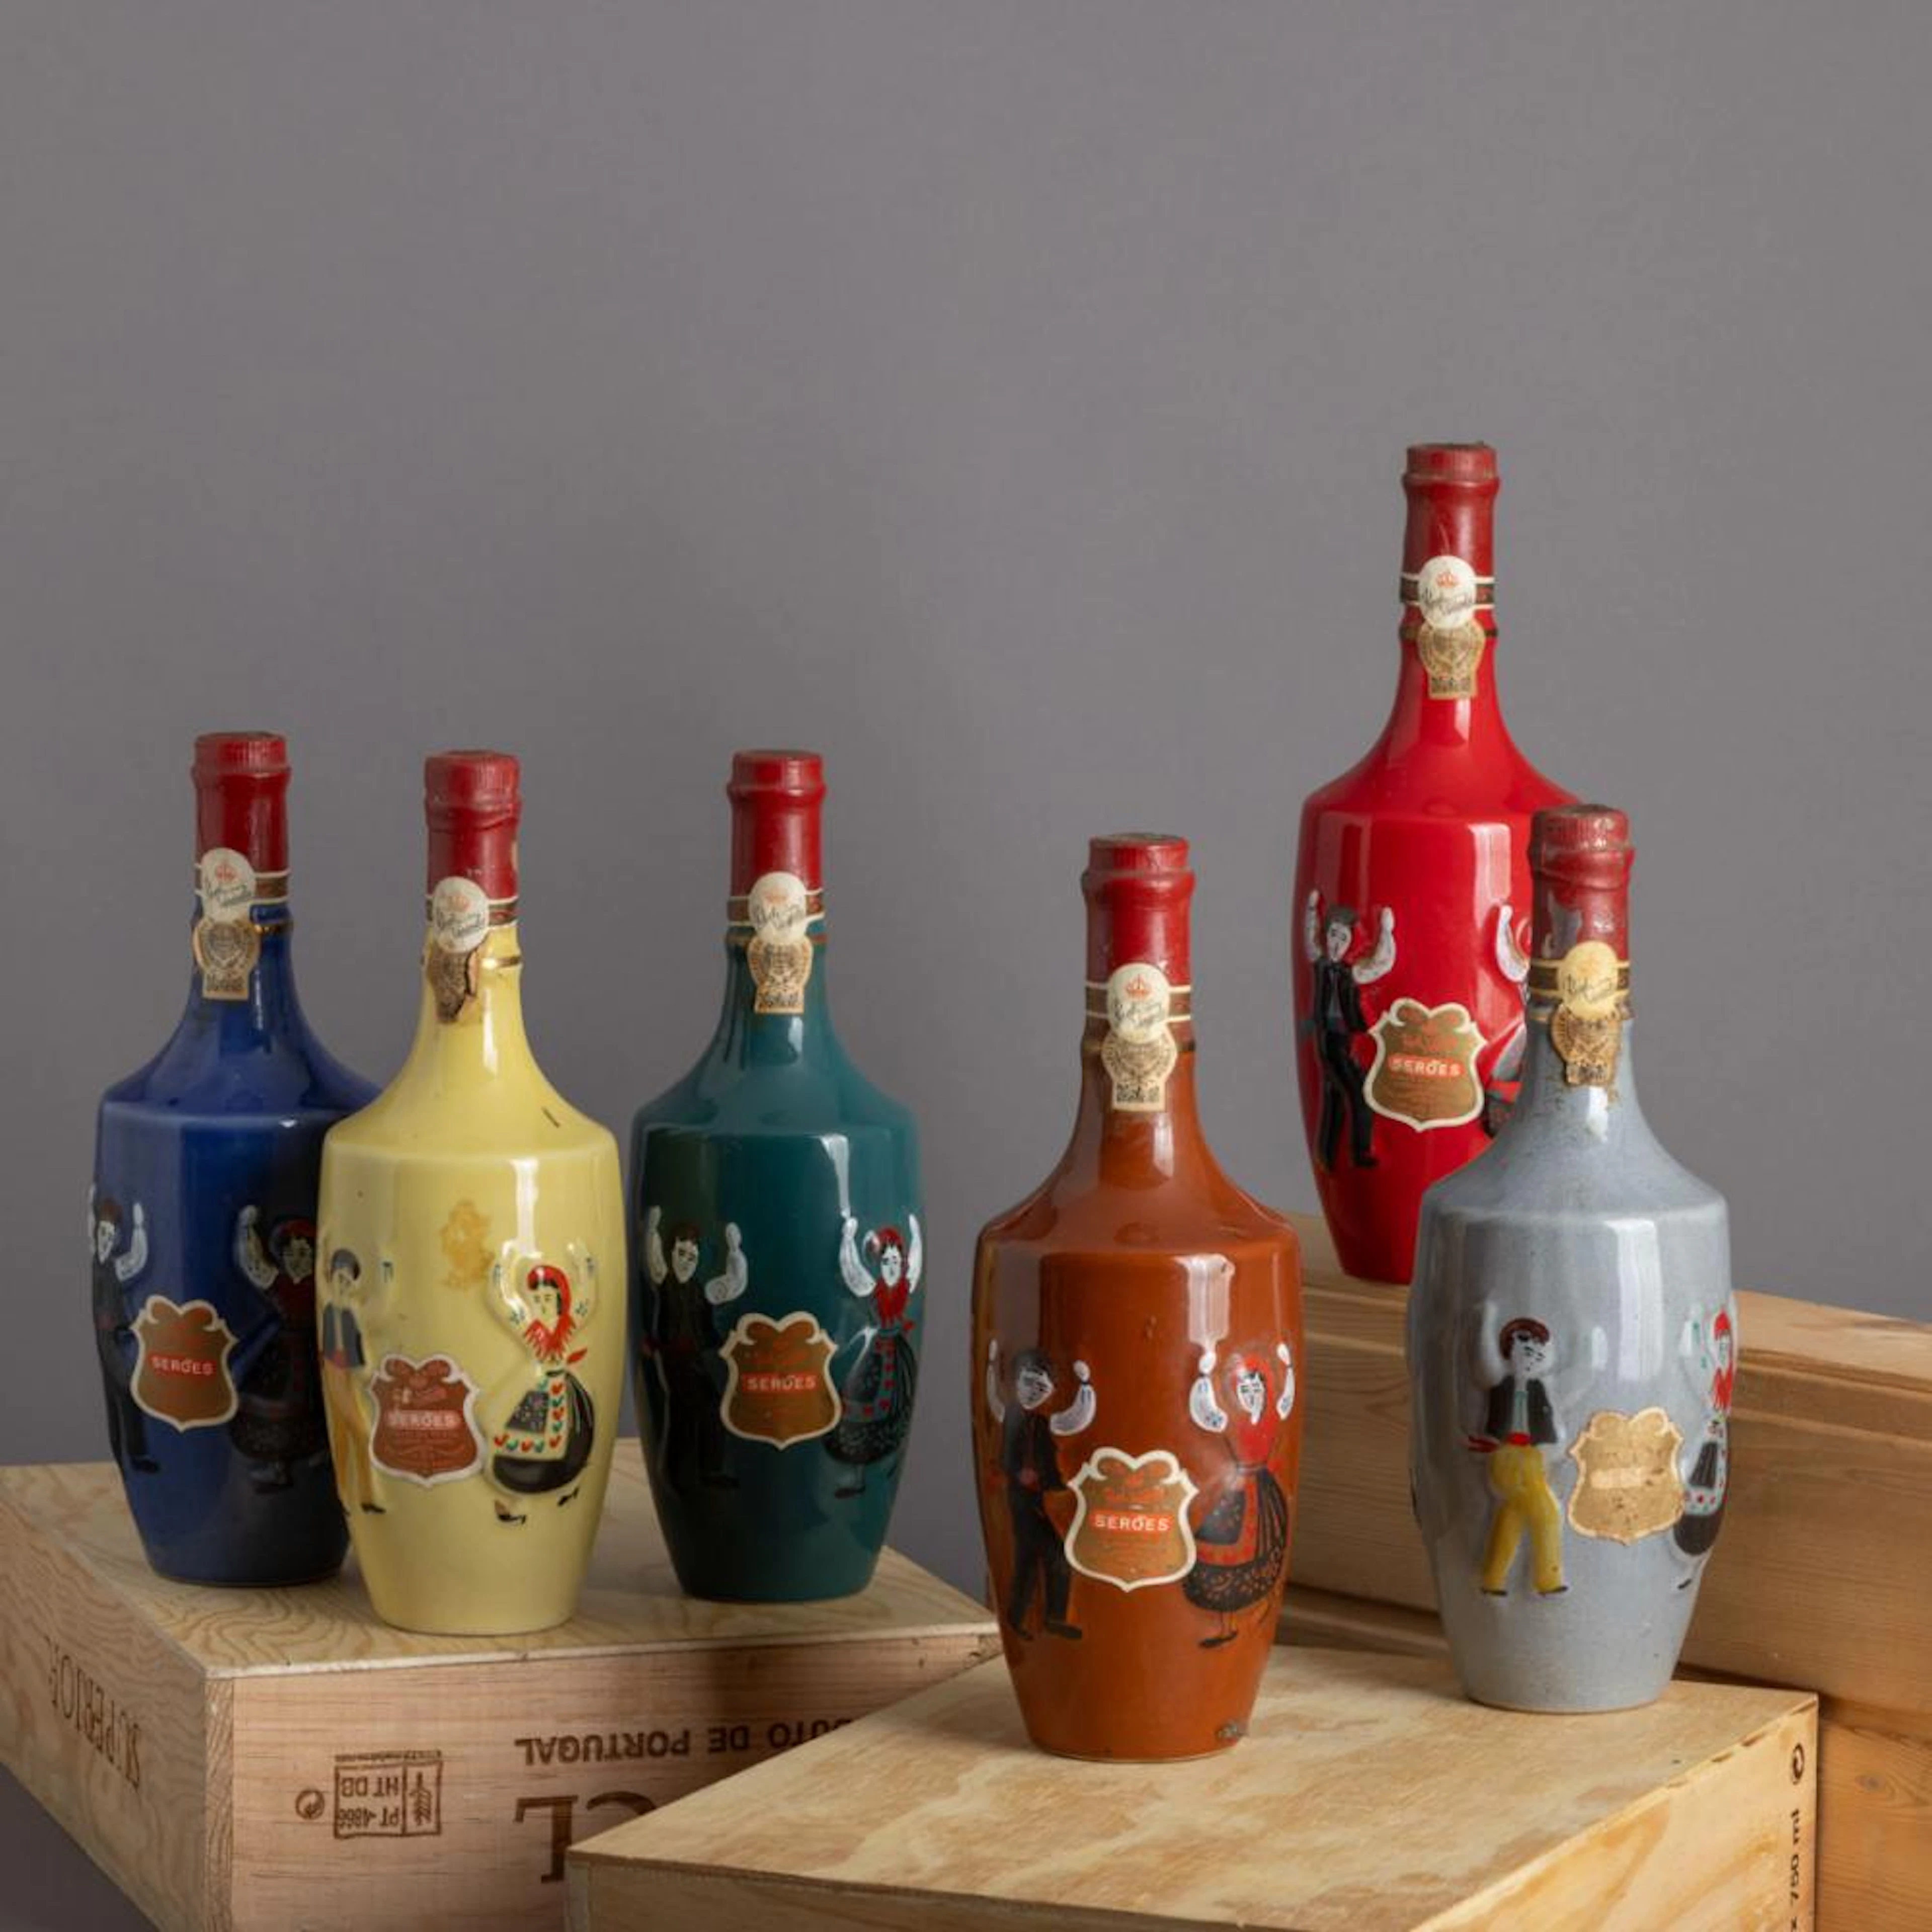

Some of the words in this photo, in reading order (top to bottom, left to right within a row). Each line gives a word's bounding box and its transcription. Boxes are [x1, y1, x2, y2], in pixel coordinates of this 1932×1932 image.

[514, 1729, 690, 1765] PORTUGAL
[707, 1725, 750, 1754] DE
[342, 1776, 368, 1797] DB
[372, 1776, 399, 1797] HT
[380, 1807, 399, 1827] PT
[1790, 1855, 1800, 1906] 750
